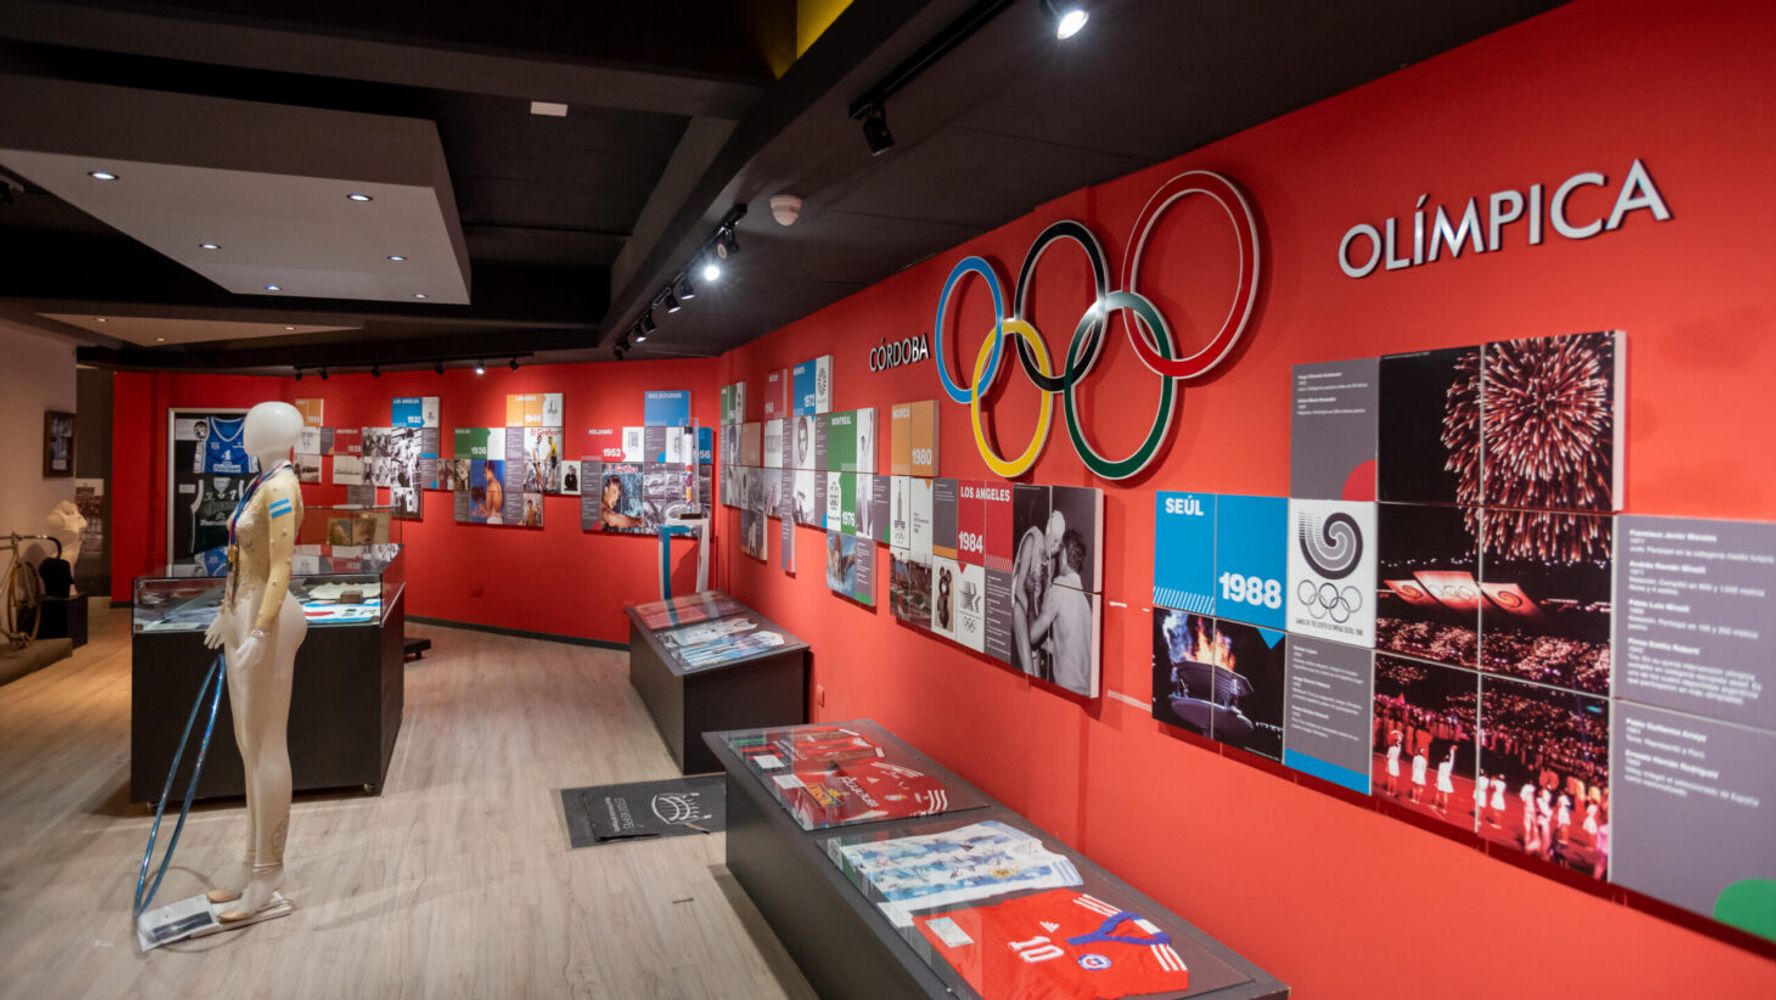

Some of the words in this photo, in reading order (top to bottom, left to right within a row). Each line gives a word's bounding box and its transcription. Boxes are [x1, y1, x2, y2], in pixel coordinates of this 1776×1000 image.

[1338, 158, 1672, 279] OLÍMPICA
[869, 333, 930, 373] CÓRDOBA
[602, 448, 622, 458] 1952
[912, 448, 932, 466] 1980
[960, 485, 974, 499] LOS
[975, 487, 1011, 502] ANGELES
[1164, 494, 1205, 517] SEÚL
[841, 511, 856, 527] 1976
[958, 530, 984, 553] 1984
[1218, 571, 1283, 610] 1988
[1008, 935, 1065, 964] 10
